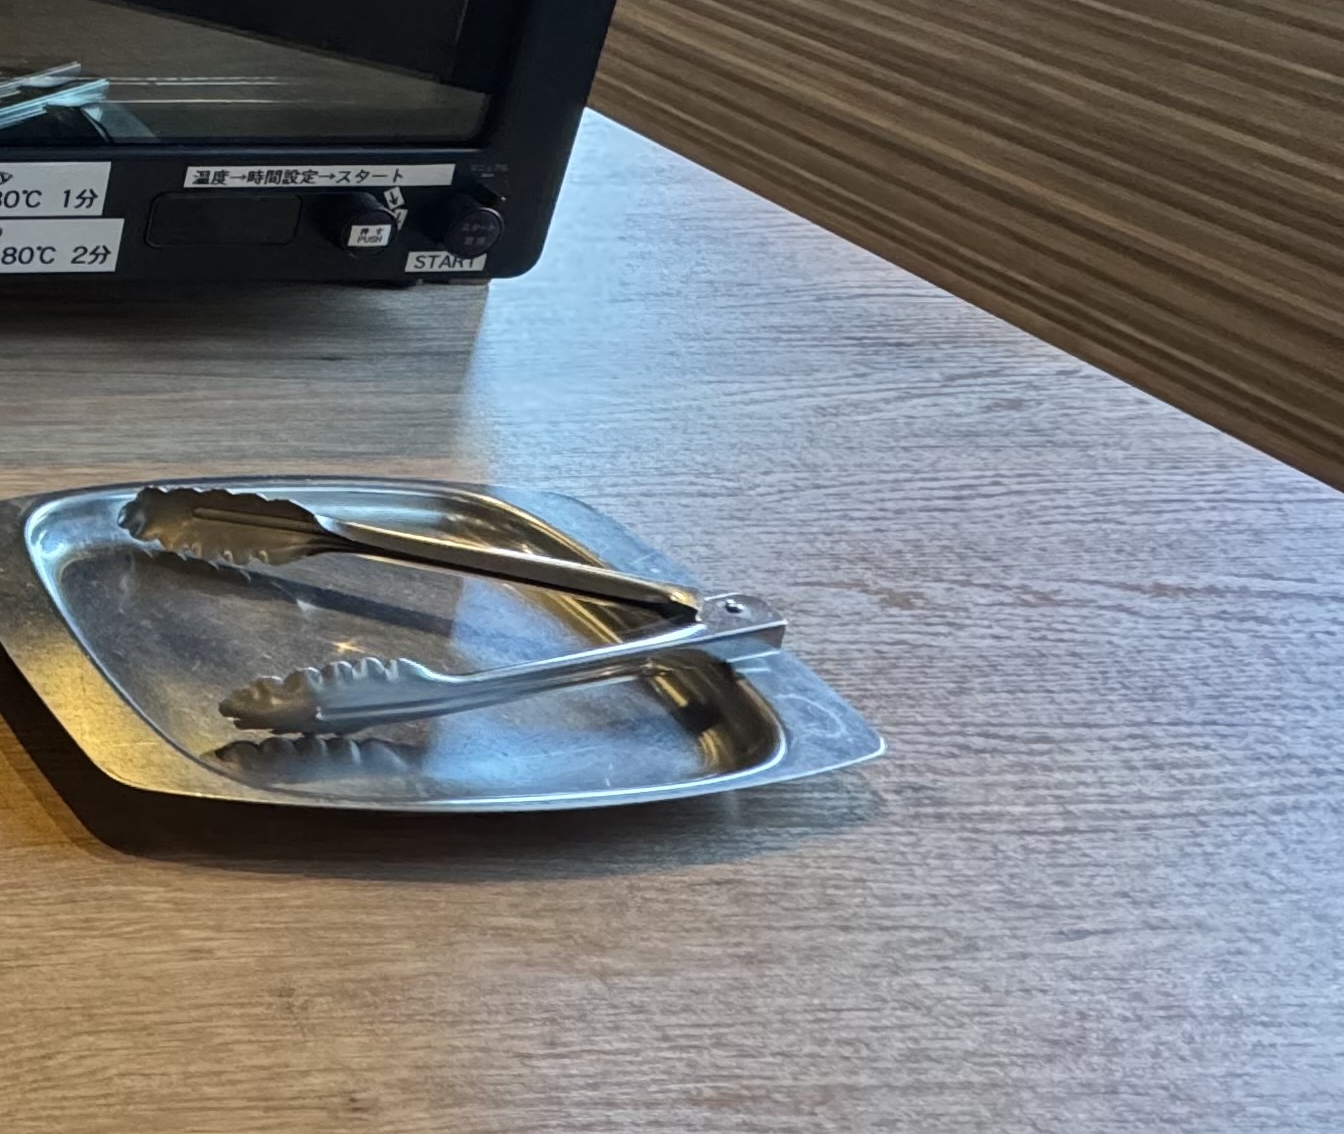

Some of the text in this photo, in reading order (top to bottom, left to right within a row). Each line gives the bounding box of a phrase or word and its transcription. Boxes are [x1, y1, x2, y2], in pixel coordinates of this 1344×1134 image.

[63, 188, 99, 209] 1分
[357, 235, 383, 243] PUSH
[71, 245, 111, 265] 2分
